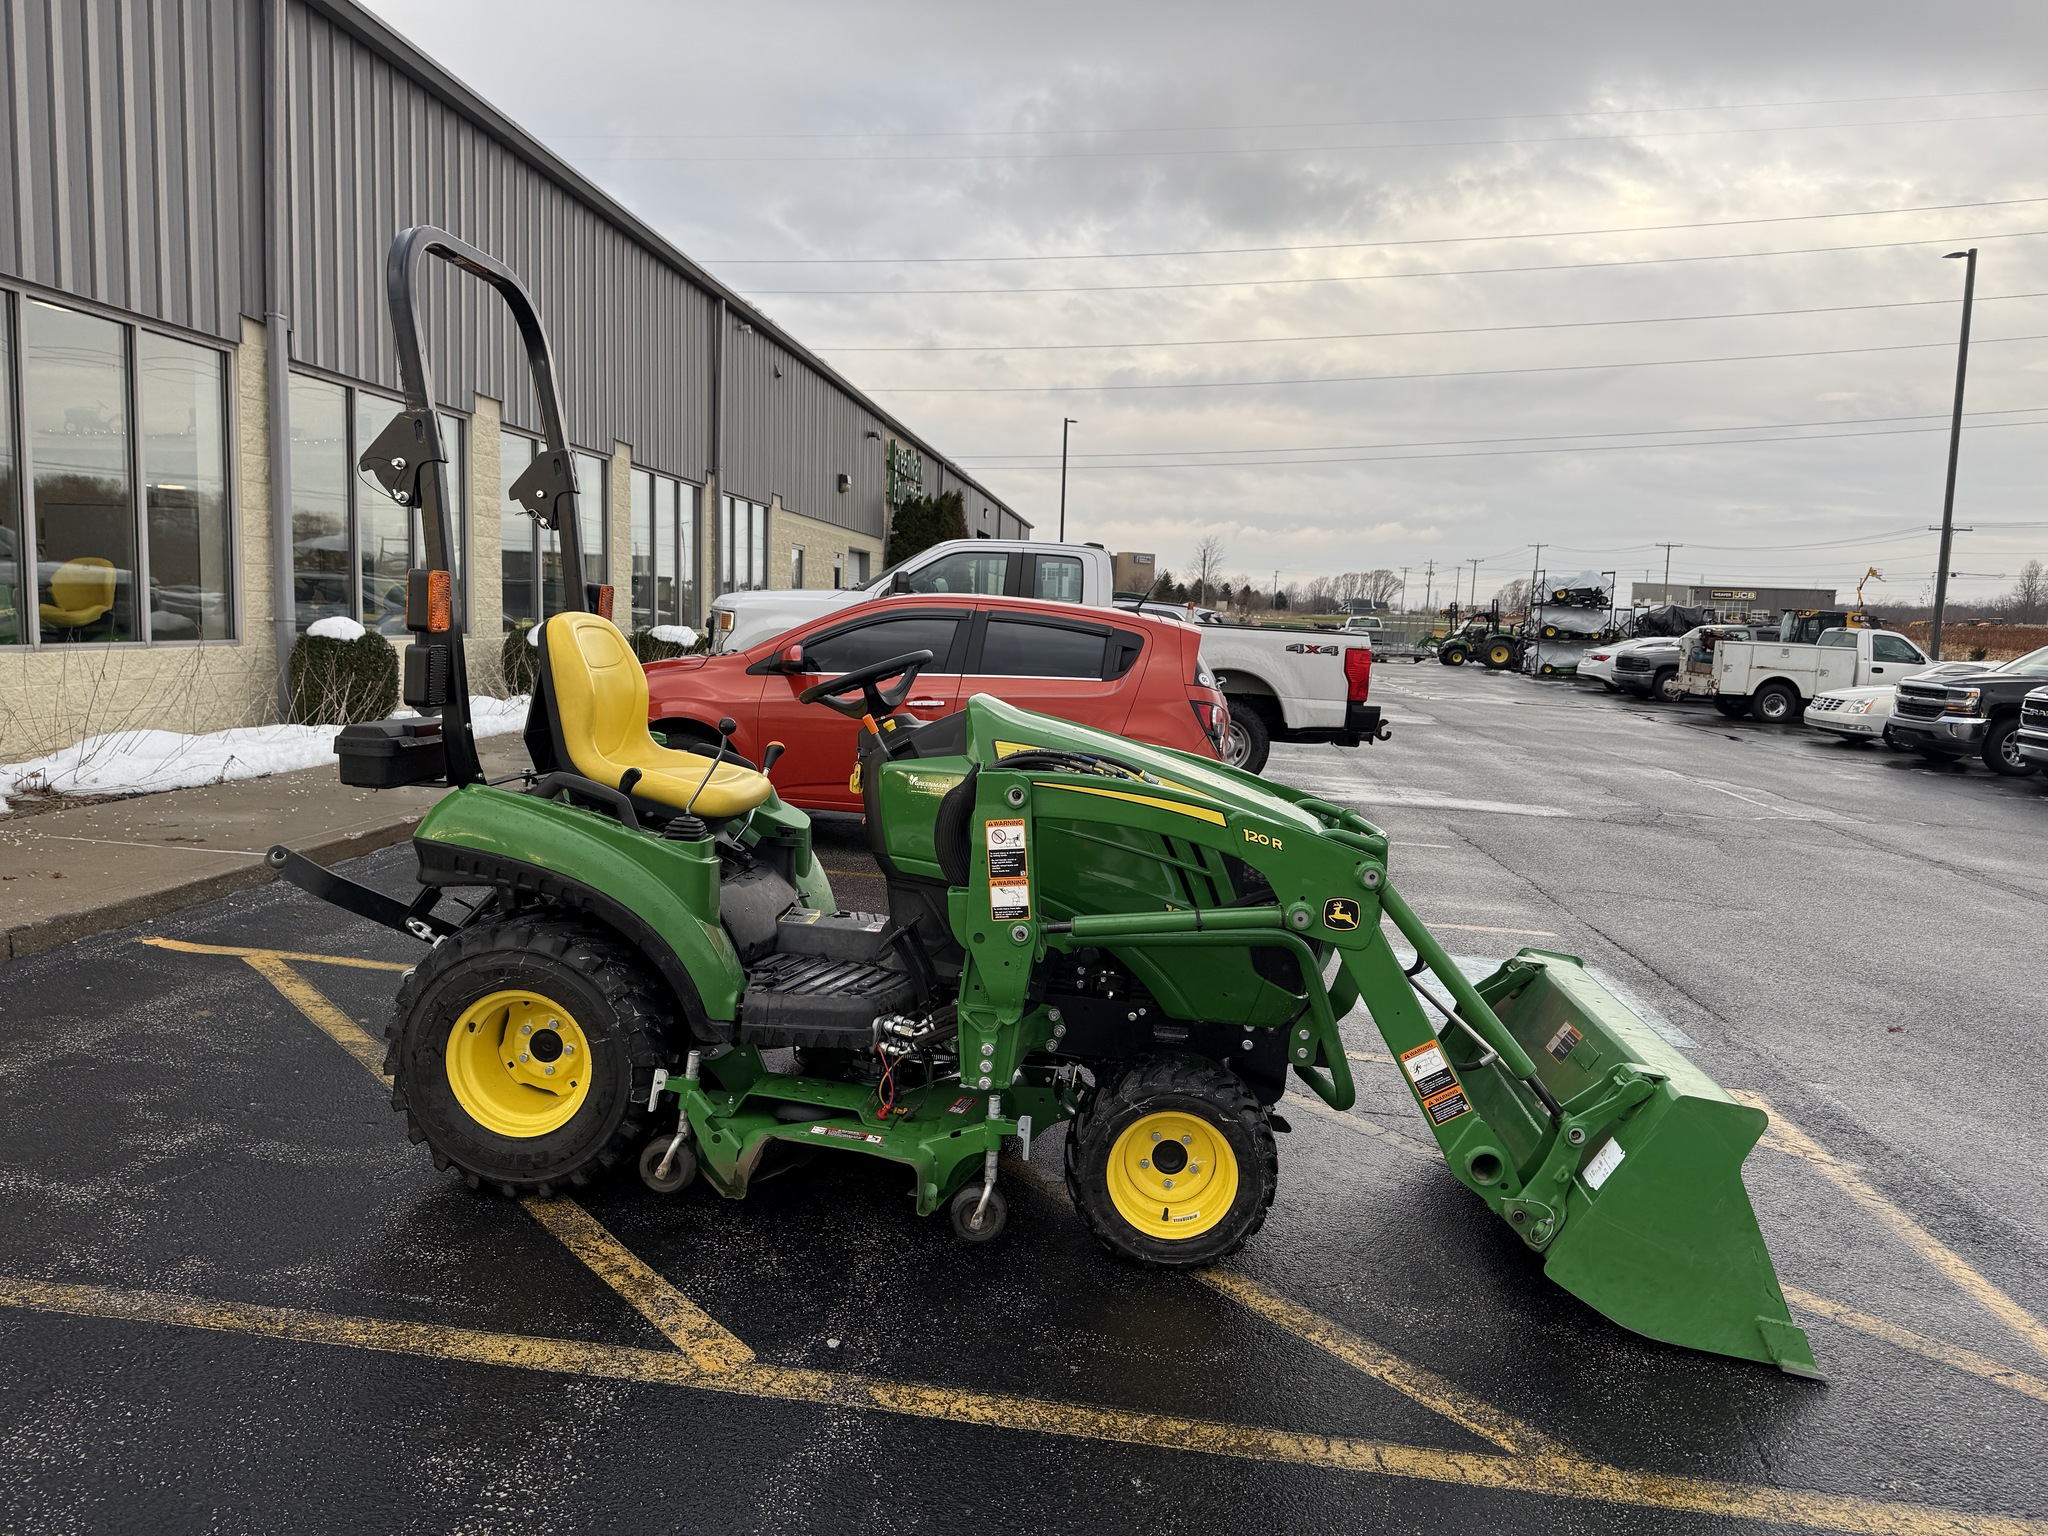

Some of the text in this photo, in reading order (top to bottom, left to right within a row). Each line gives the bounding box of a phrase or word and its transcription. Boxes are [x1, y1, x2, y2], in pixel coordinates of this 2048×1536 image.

[1734, 591, 1755, 599] JCB
[914, 780, 951, 789] GREENMARK
[1242, 828, 1270, 845] 120
[1409, 1043, 1434, 1057] WARNING
[1434, 1089, 1459, 1102] WARNING
